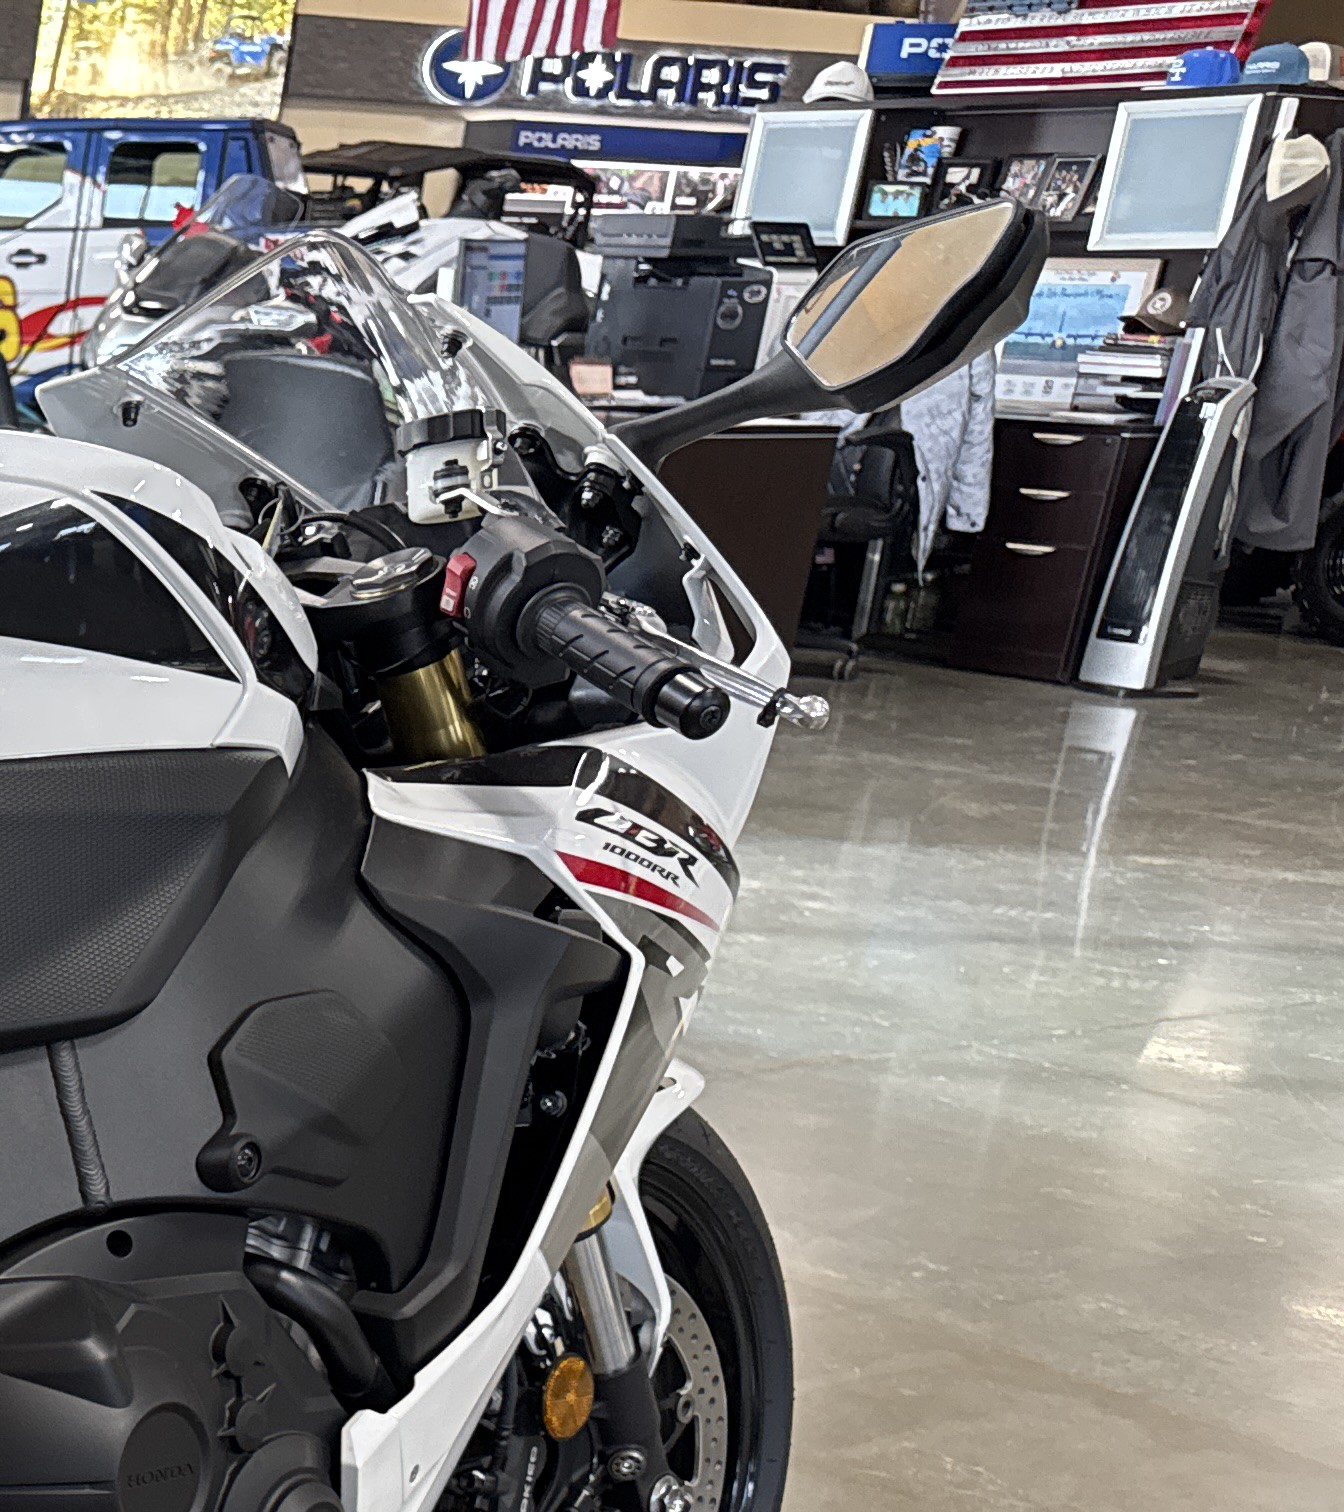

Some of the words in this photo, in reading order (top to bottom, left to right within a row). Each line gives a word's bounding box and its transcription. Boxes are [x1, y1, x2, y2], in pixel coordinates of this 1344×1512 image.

[521, 51, 790, 108] POLARIS
[518, 130, 602, 150] POLARIS
[575, 807, 700, 889] CBR
[602, 842, 681, 888] 1000RR
[126, 1463, 195, 1489] HONDA
